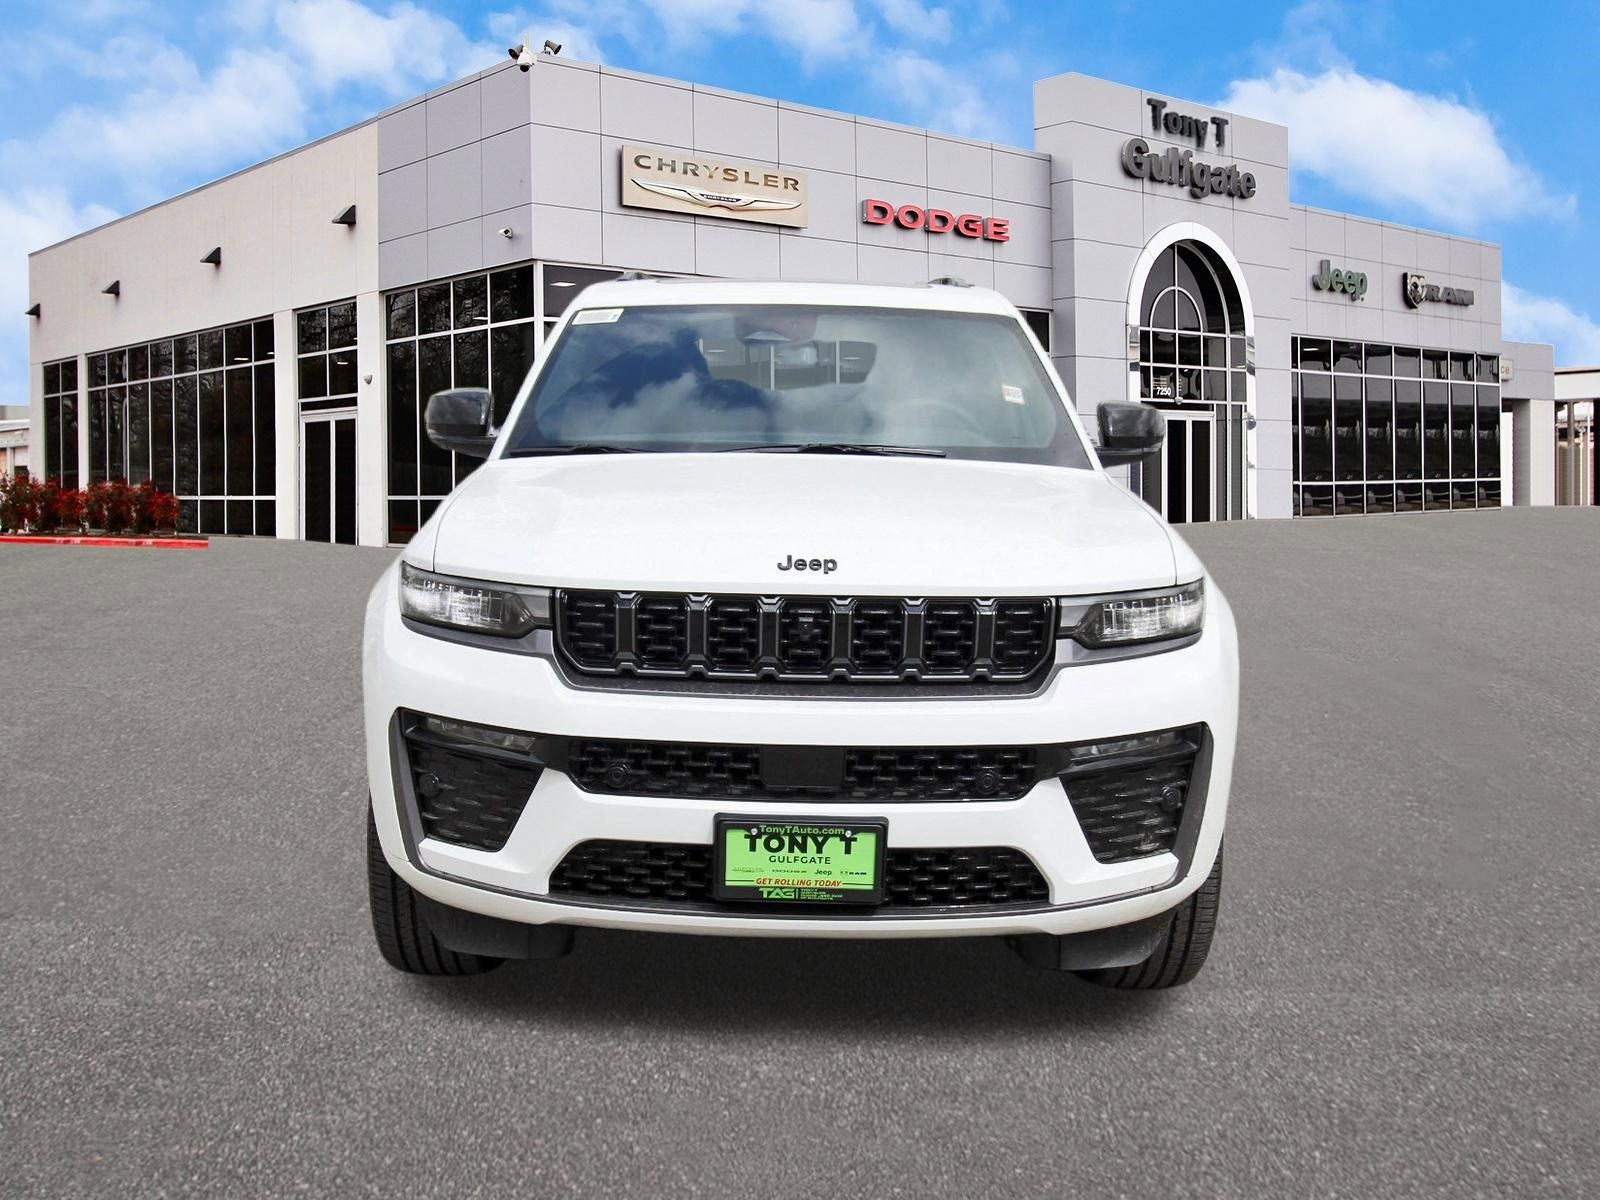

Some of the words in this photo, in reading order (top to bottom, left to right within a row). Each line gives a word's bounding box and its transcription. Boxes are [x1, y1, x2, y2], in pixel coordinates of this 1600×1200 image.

[1146, 98, 1209, 149] Tony
[1210, 116, 1229, 147] T
[633, 153, 801, 193] CHRYSLER
[1121, 138, 1257, 199] Gulfgate
[862, 198, 1011, 243] DODGE
[1312, 259, 1368, 302] Jeep
[1425, 283, 1475, 306] RAM
[1156, 386, 1172, 396] 7250
[777, 554, 838, 574] Jeep
[760, 825, 845, 836] TonyTAuto.com
[744, 833, 830, 854] TONY
[840, 836, 858, 855] T
[768, 855, 831, 865] GULFGATE
[756, 877, 772, 885] GET
[774, 878, 812, 886] ROLLING
[815, 879, 842, 887] TODAY
[814, 868, 833, 876] Jeep
